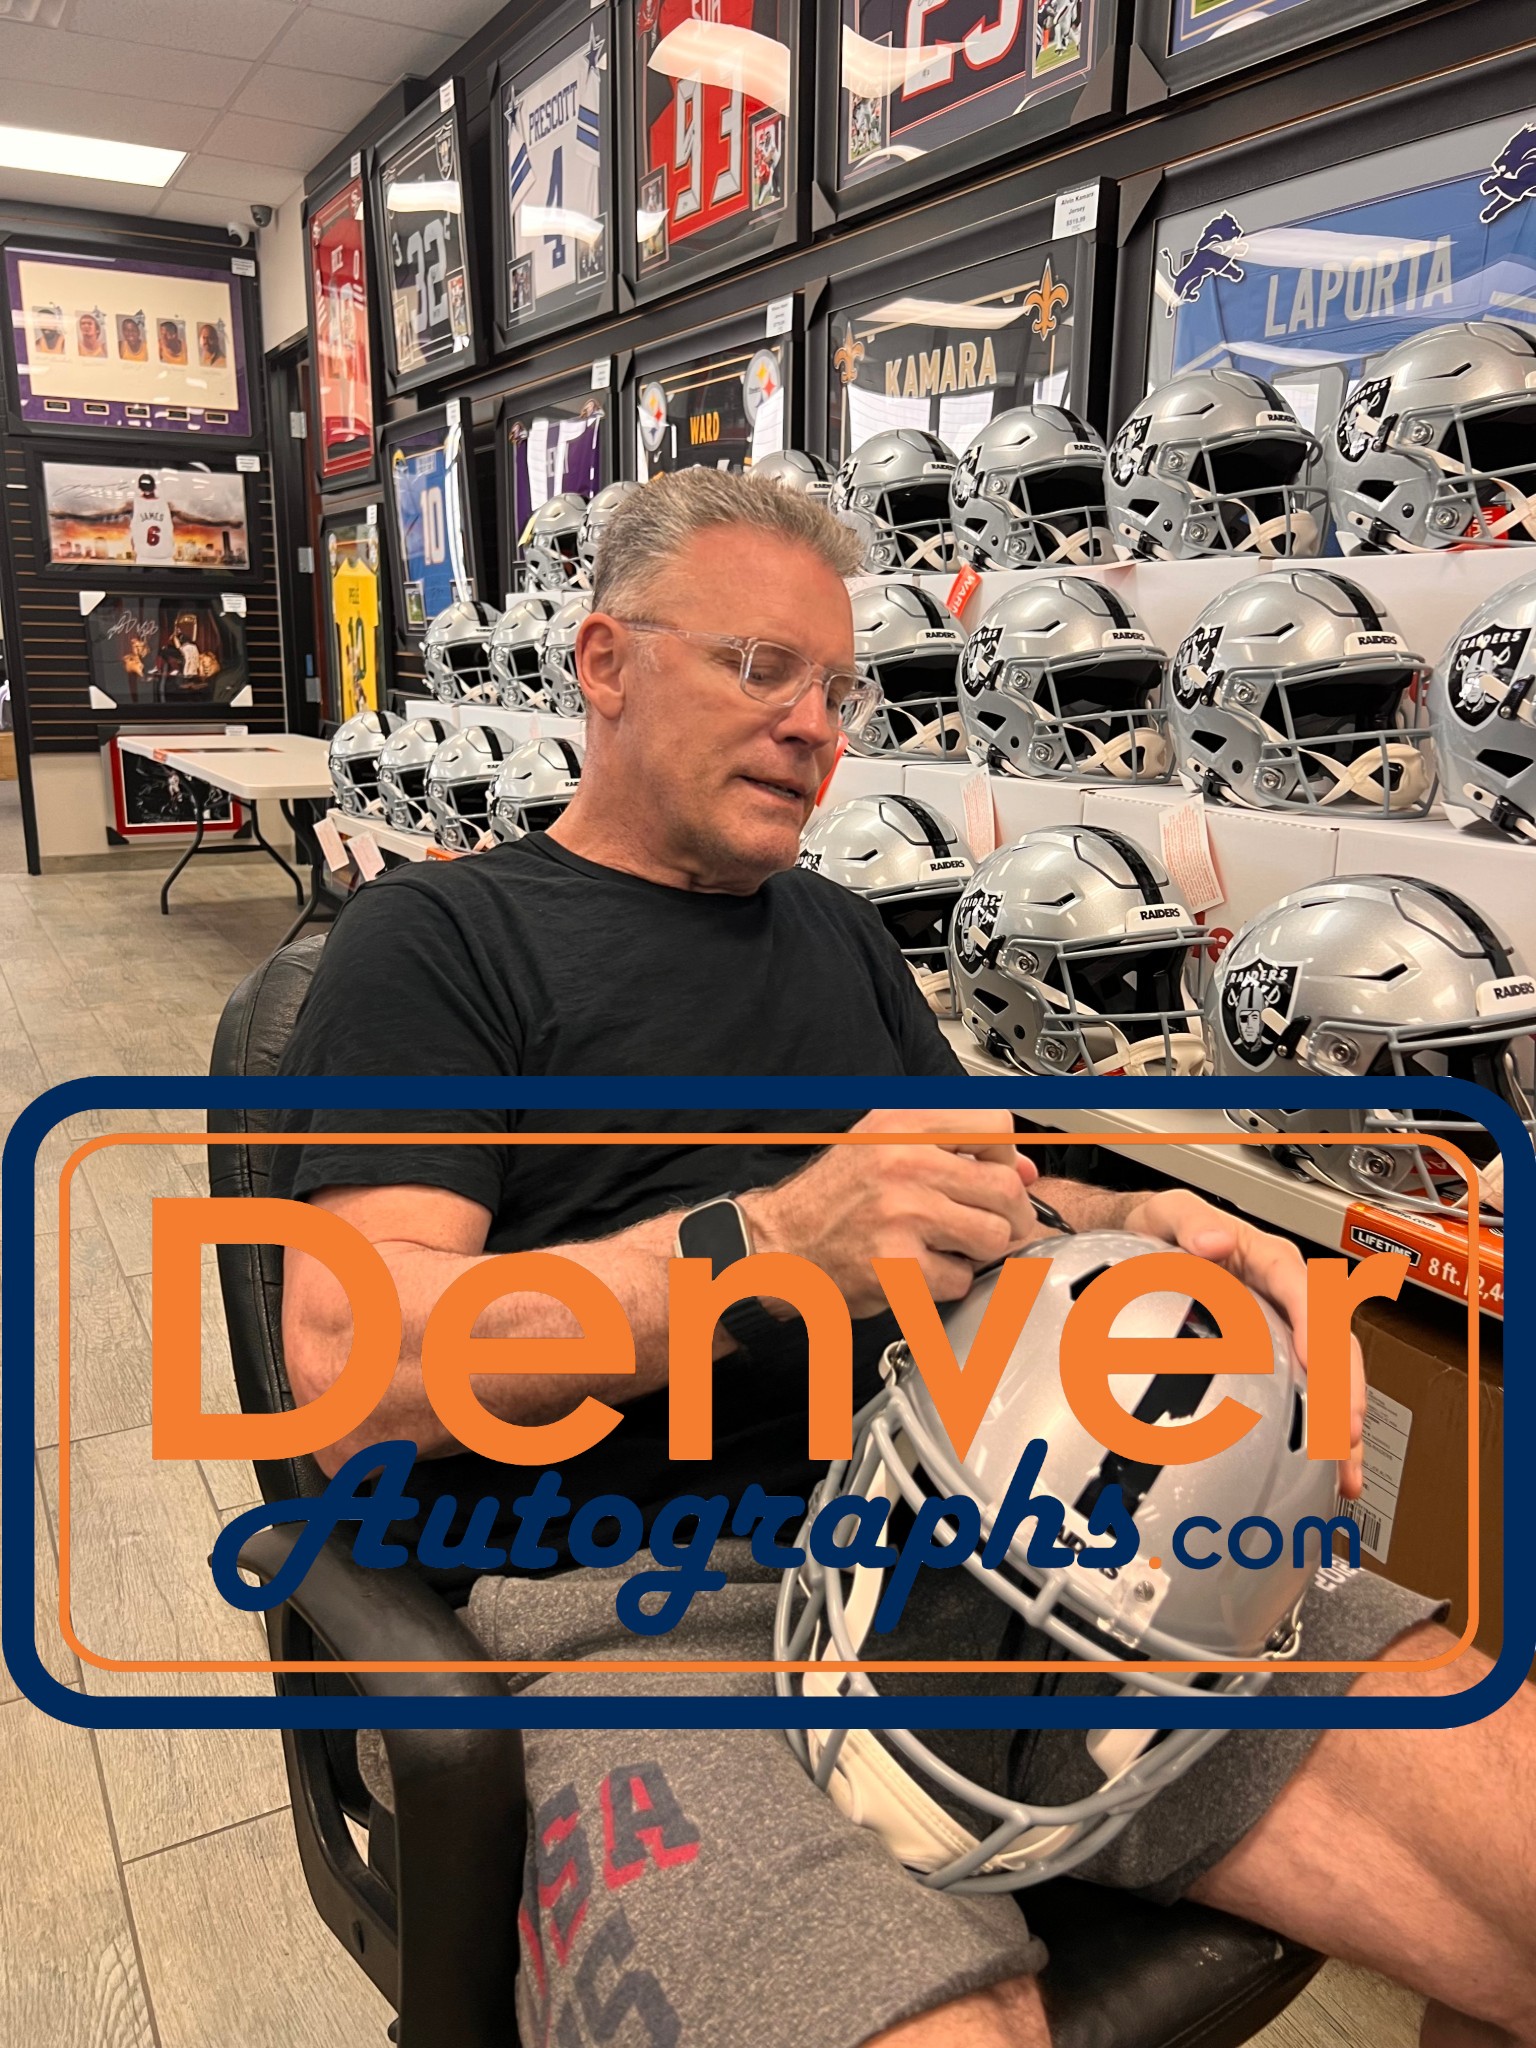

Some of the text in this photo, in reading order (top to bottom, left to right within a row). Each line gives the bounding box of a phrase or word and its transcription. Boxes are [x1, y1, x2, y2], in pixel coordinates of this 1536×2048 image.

[529, 80, 578, 146] PRESCOTT
[543, 145, 566, 269] 4
[407, 218, 449, 334] 32
[1264, 234, 1453, 338] LAPORTA
[885, 336, 998, 399] KAMARA
[689, 410, 721, 446] WARD
[1267, 413, 1297, 425] RAIDERS
[1073, 443, 1103, 454] RAIDERS
[139, 512, 165, 523] JAMES
[420, 486, 446, 566] 10
[146, 525, 161, 547] 6
[925, 631, 956, 639] RAIDERS
[1112, 631, 1146, 642] RAIDERS
[1358, 635, 1398, 646] RAIDERS
[929, 859, 965, 872] RAIDERS
[1139, 907, 1181, 921] RAIDERS
[1493, 981, 1536, 1000] RAIDERS
[1356, 1230, 1413, 1258] LIFETIME
[1428, 1257, 1440, 1276] 8
[1442, 1261, 1461, 1286] ft.
